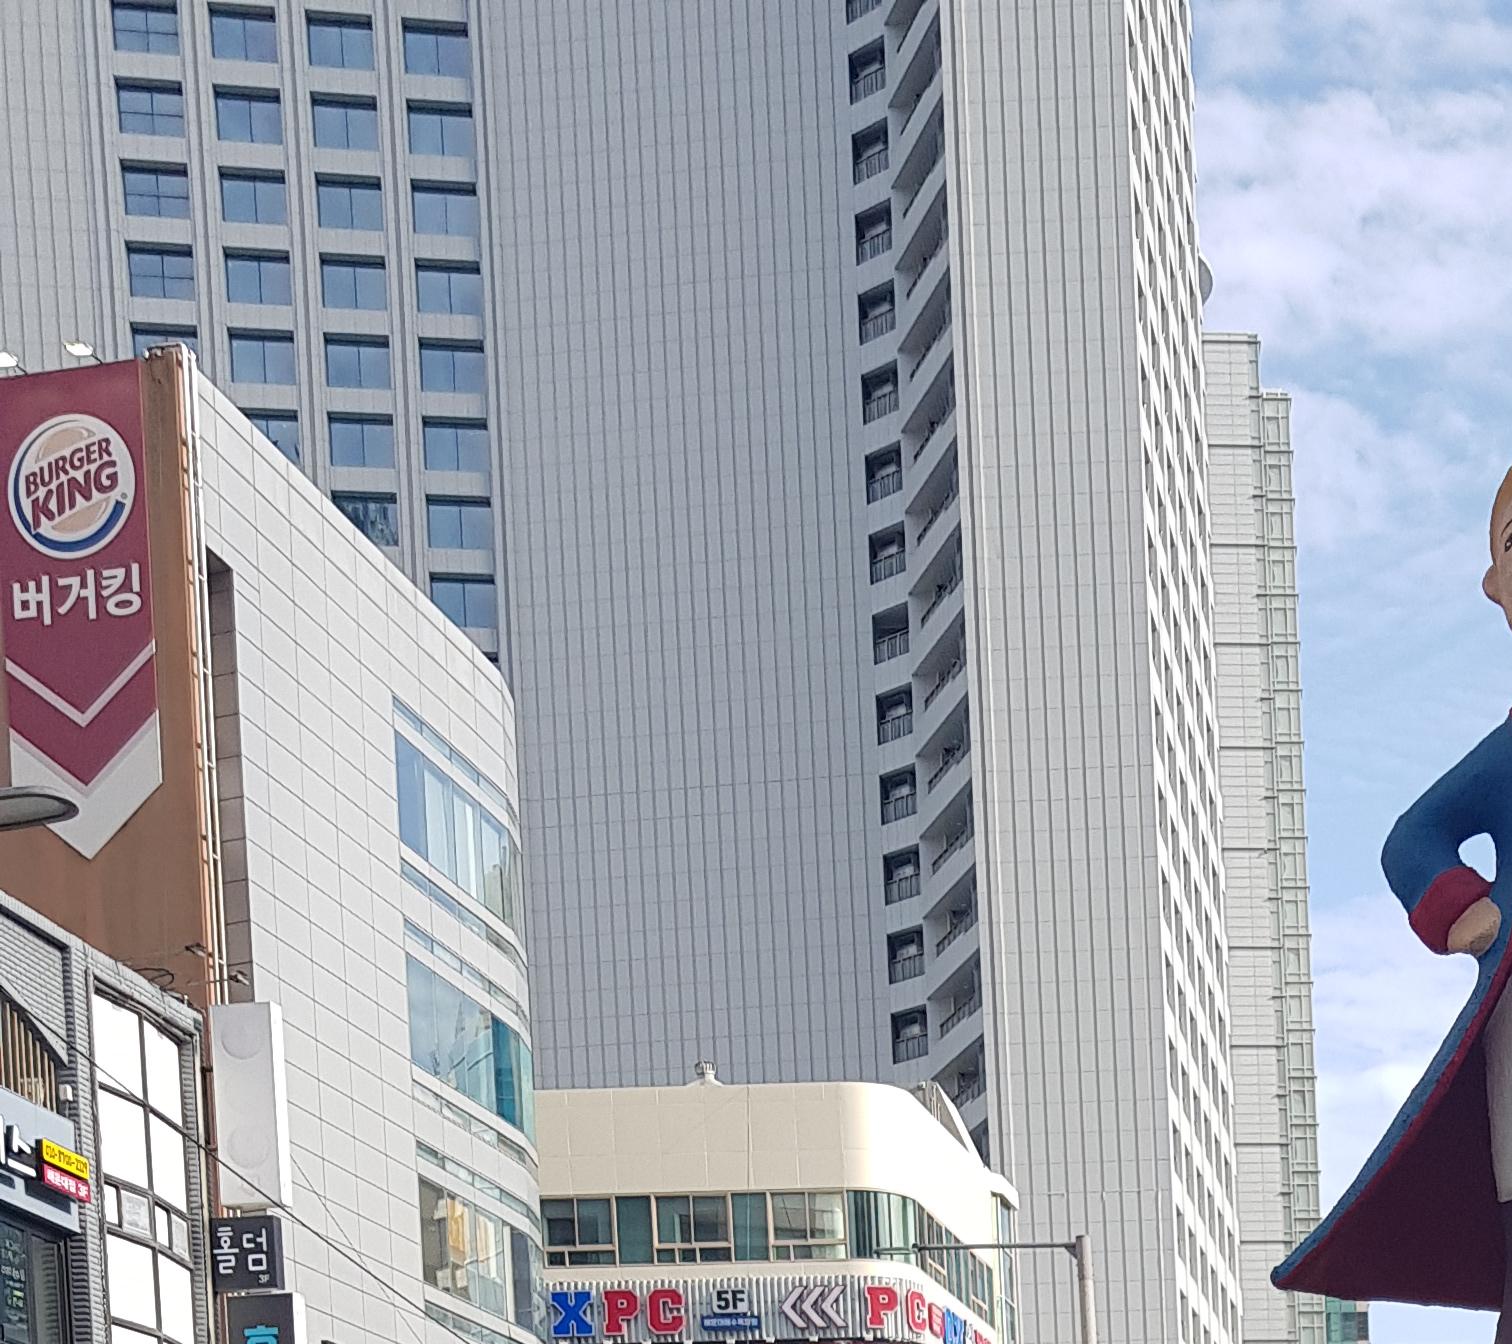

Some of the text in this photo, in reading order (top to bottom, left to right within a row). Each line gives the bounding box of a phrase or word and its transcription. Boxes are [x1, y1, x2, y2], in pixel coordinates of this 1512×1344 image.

[25, 436, 112, 498] BURGER
[30, 456, 119, 534] KING
[12, 562, 143, 626] 버거킹
[716, 1289, 746, 1311] 5F
